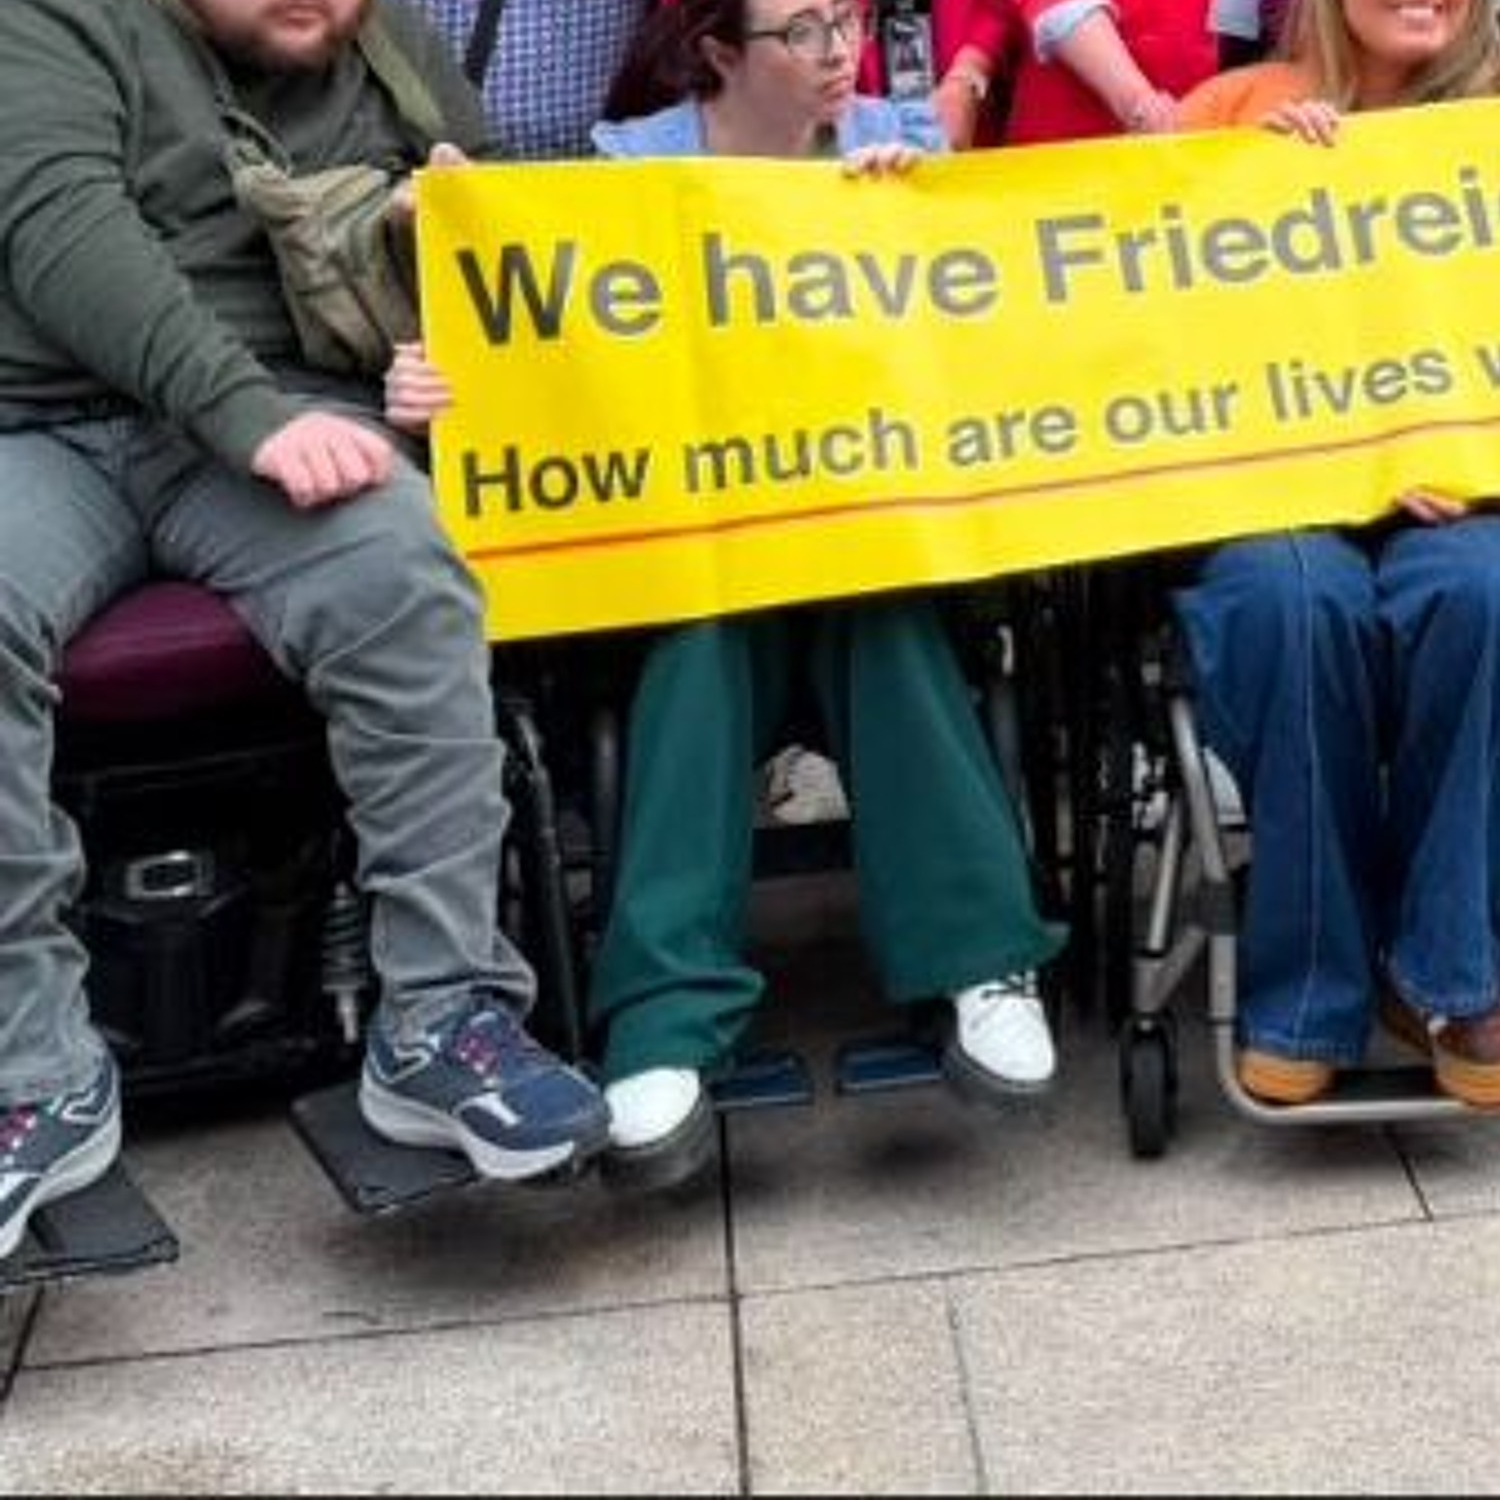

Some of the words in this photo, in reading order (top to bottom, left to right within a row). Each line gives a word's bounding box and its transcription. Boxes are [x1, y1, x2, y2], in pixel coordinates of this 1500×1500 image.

[456, 239, 662, 347] We
[701, 230, 998, 328] have
[462, 443, 651, 518] How
[682, 406, 920, 495] much
[946, 404, 1078, 469] are
[1103, 380, 1241, 446] our
[1266, 344, 1452, 424] lives
